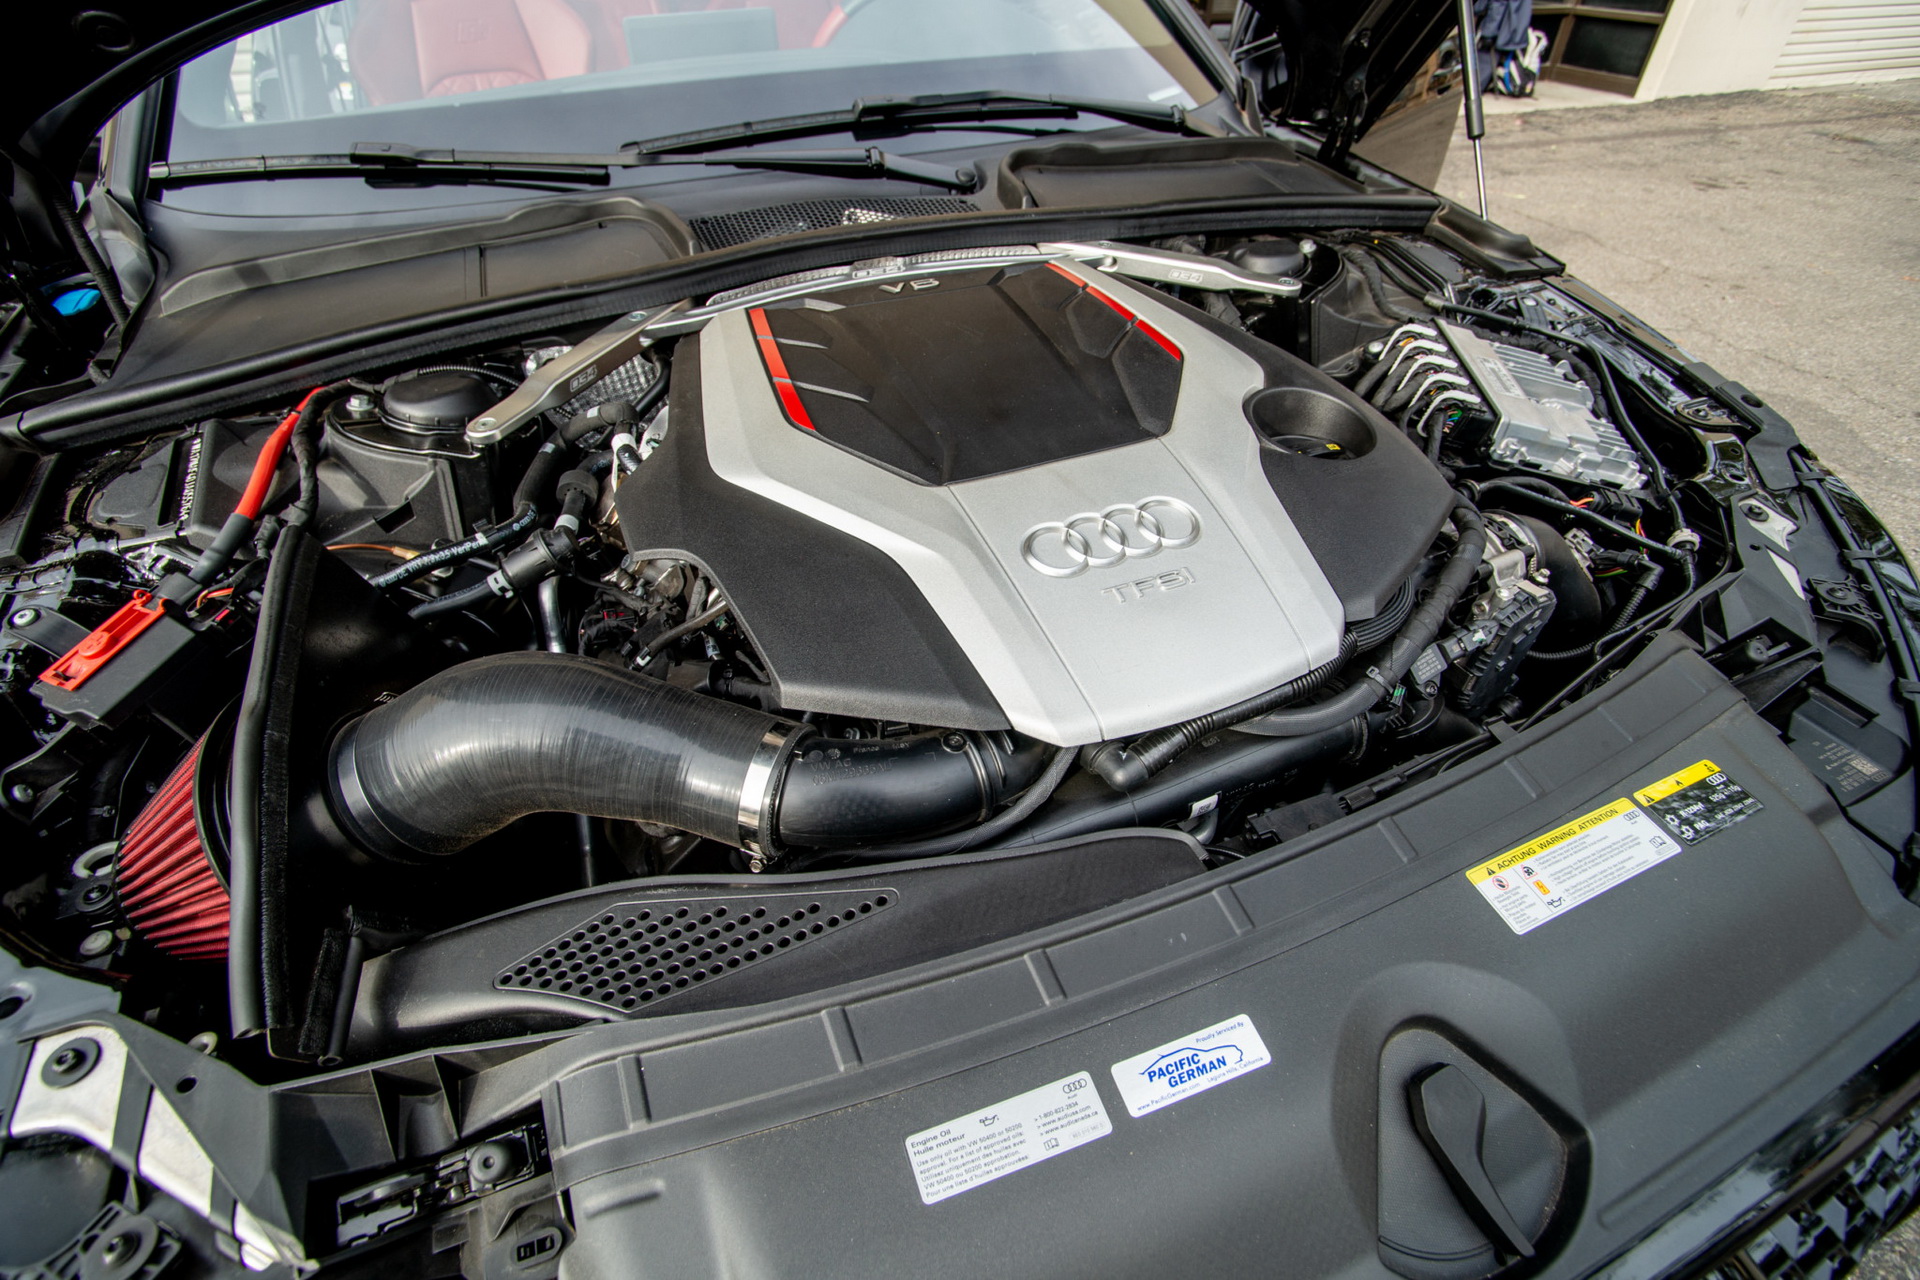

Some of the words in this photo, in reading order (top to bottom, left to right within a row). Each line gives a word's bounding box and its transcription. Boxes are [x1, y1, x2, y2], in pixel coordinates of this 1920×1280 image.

[879, 278, 940, 294] V6
[1101, 567, 1195, 603] TFSI
[810, 761, 831, 772] VW
[835, 758, 852, 769] AG
[1497, 846, 1536, 872] ACHTUNG
[1536, 828, 1577, 852] WARNING
[1577, 807, 1619, 834] ATTENTION
[1195, 1033, 1215, 1044] Proudly
[1215, 1023, 1237, 1036] Serviced
[1236, 1020, 1244, 1030] By
[1147, 1053, 1201, 1082] PACIFIC
[1168, 1055, 1227, 1088] GERMAN
[910, 1134, 938, 1148] Engine
[939, 1128, 951, 1137] Oil
[913, 1145, 934, 1157] Huile
[935, 1133, 965, 1148] moteur
